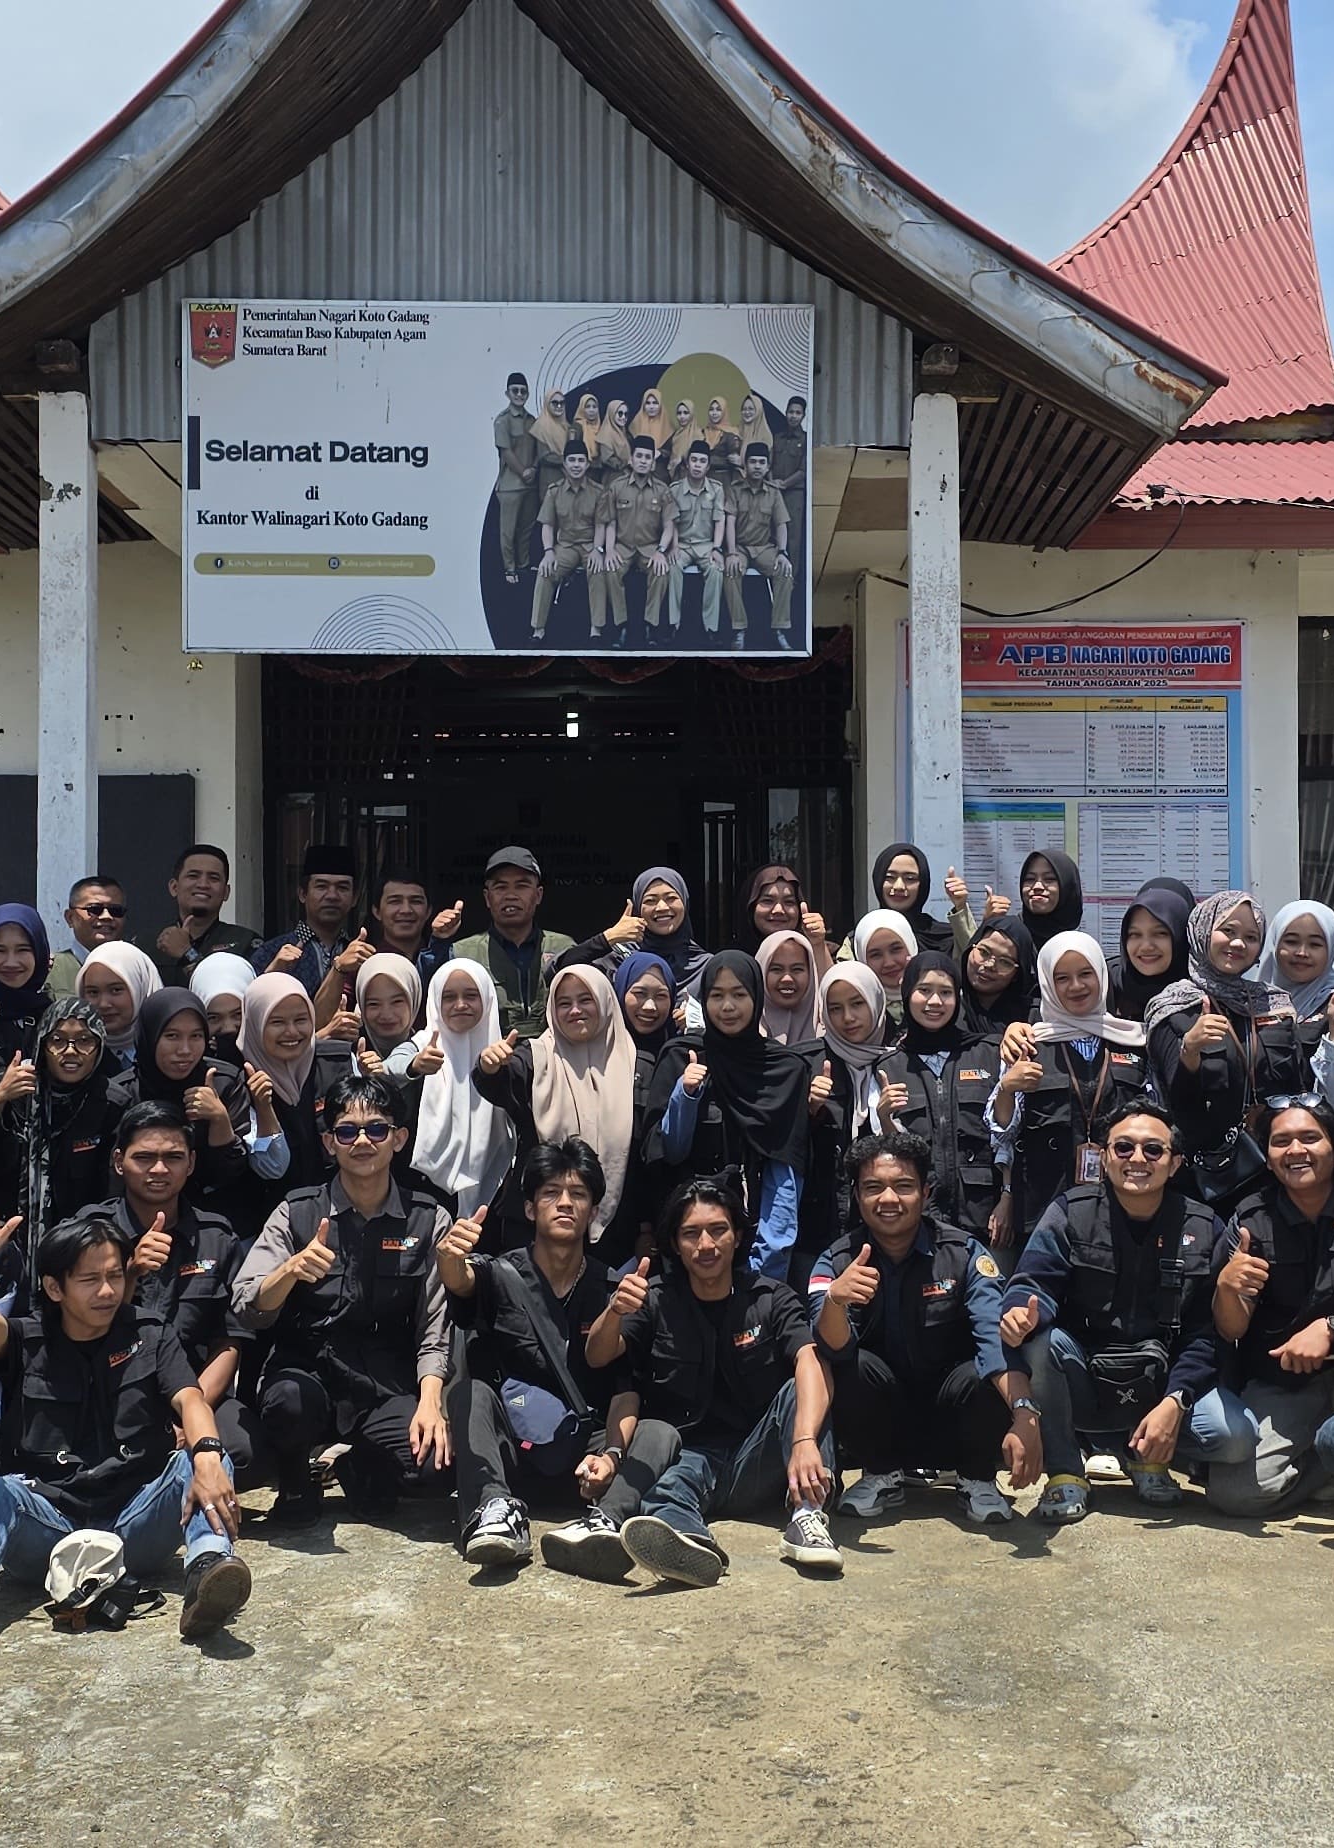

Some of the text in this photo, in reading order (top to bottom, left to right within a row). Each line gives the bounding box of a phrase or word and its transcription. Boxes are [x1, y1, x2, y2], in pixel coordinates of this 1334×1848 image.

[196, 304, 232, 312] AGAM
[243, 308, 429, 325] Pemerintahan Nagari Koto Gadang
[242, 326, 426, 343] Kecamatan Baso Kabupaten Agam
[242, 344, 327, 356] Sumatera Barat
[205, 439, 429, 468] Selamat Datang
[305, 486, 320, 500] di
[196, 510, 429, 530] Kantor Walinagari Koto Gadang
[998, 645, 1231, 666] APB NAGARI KOTO GADANG
[1018, 668, 1196, 678] KECAMATAN BASO KABUPATEN AGAM
[1046, 679, 1168, 688] TAHUN ANGGARAN 2025
